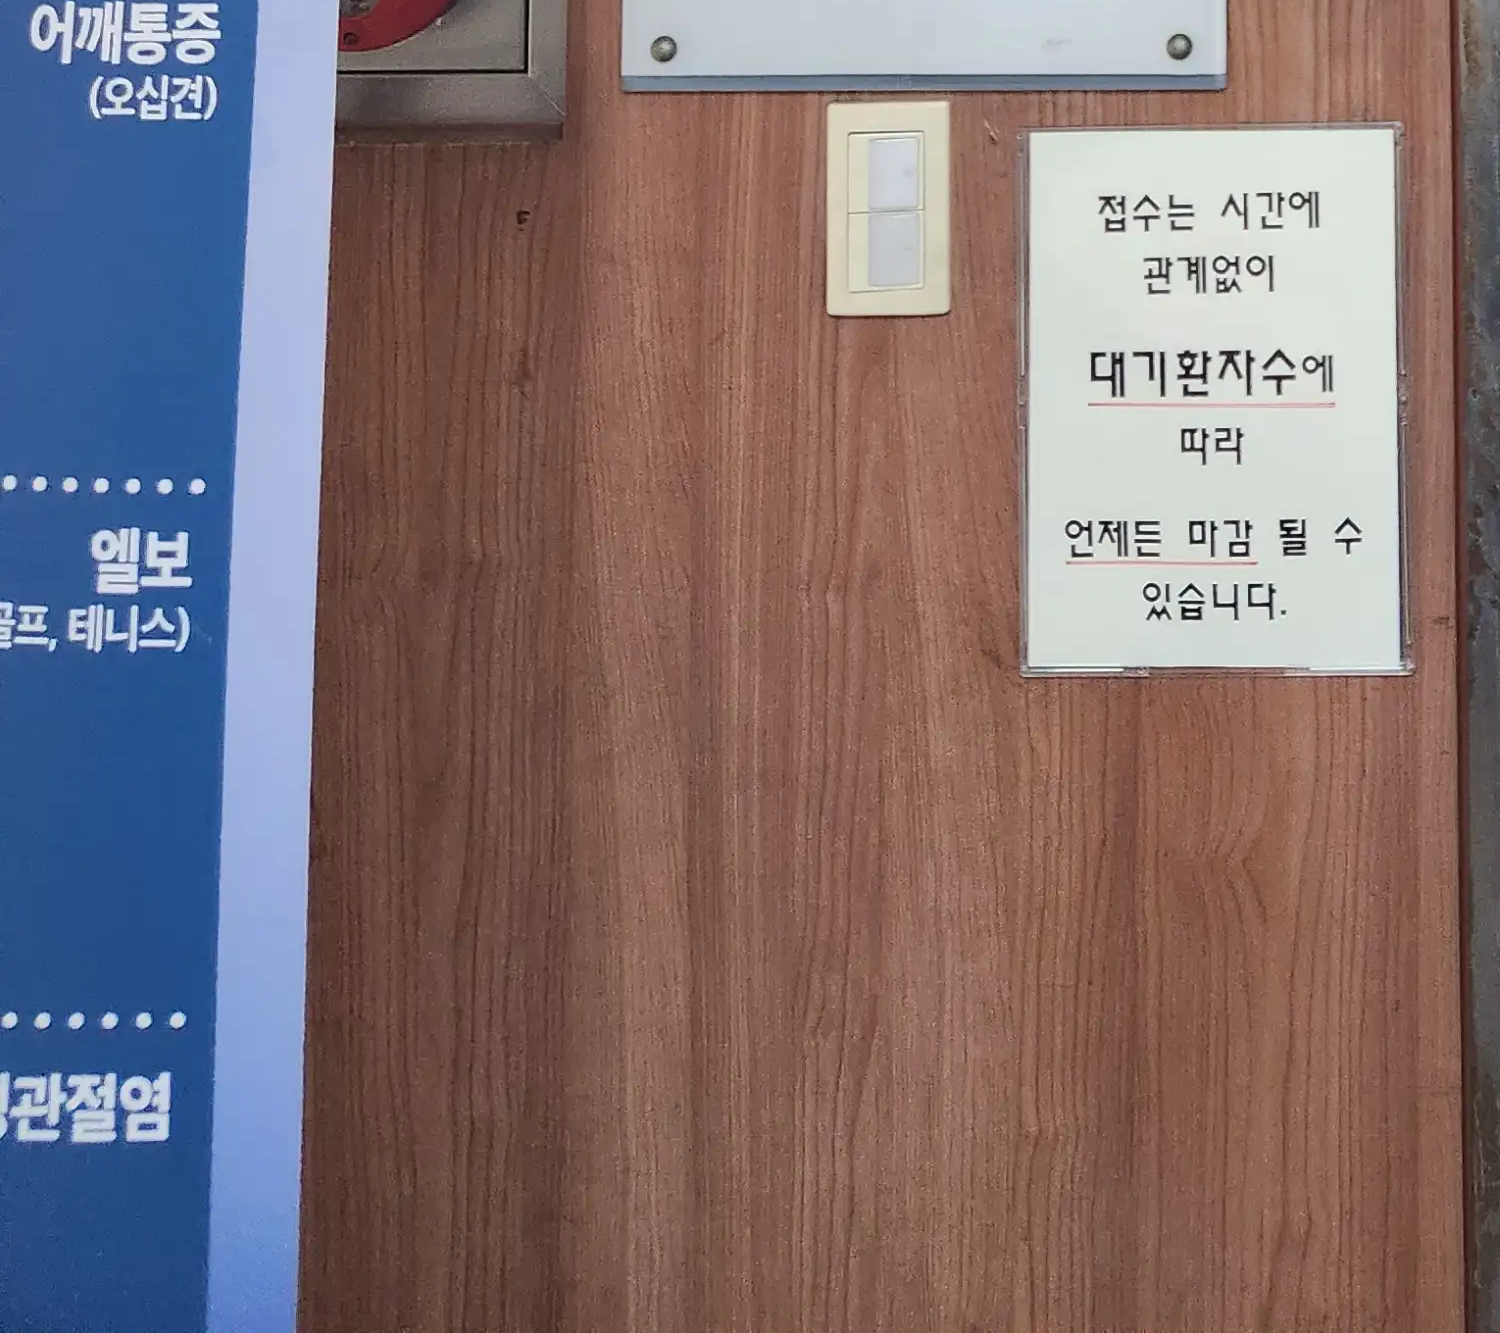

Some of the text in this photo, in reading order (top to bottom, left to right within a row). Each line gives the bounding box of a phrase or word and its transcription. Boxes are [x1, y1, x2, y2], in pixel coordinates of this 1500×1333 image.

[30, 0, 221, 66] 어깨통증
[89, 75, 218, 121] (오십견)
[1098, 191, 1321, 233] 접수는 시간에
[1143, 254, 1275, 295] 관계없이
[1089, 348, 1335, 399] 대기환자수에
[1180, 427, 1245, 465] 따라
[1064, 517, 1363, 559] 언제든 마감 될 수
[91, 527, 193, 595] 엘보
[1142, 581, 1287, 621] 있습니다.
[68, 604, 191, 653] 테니스)
